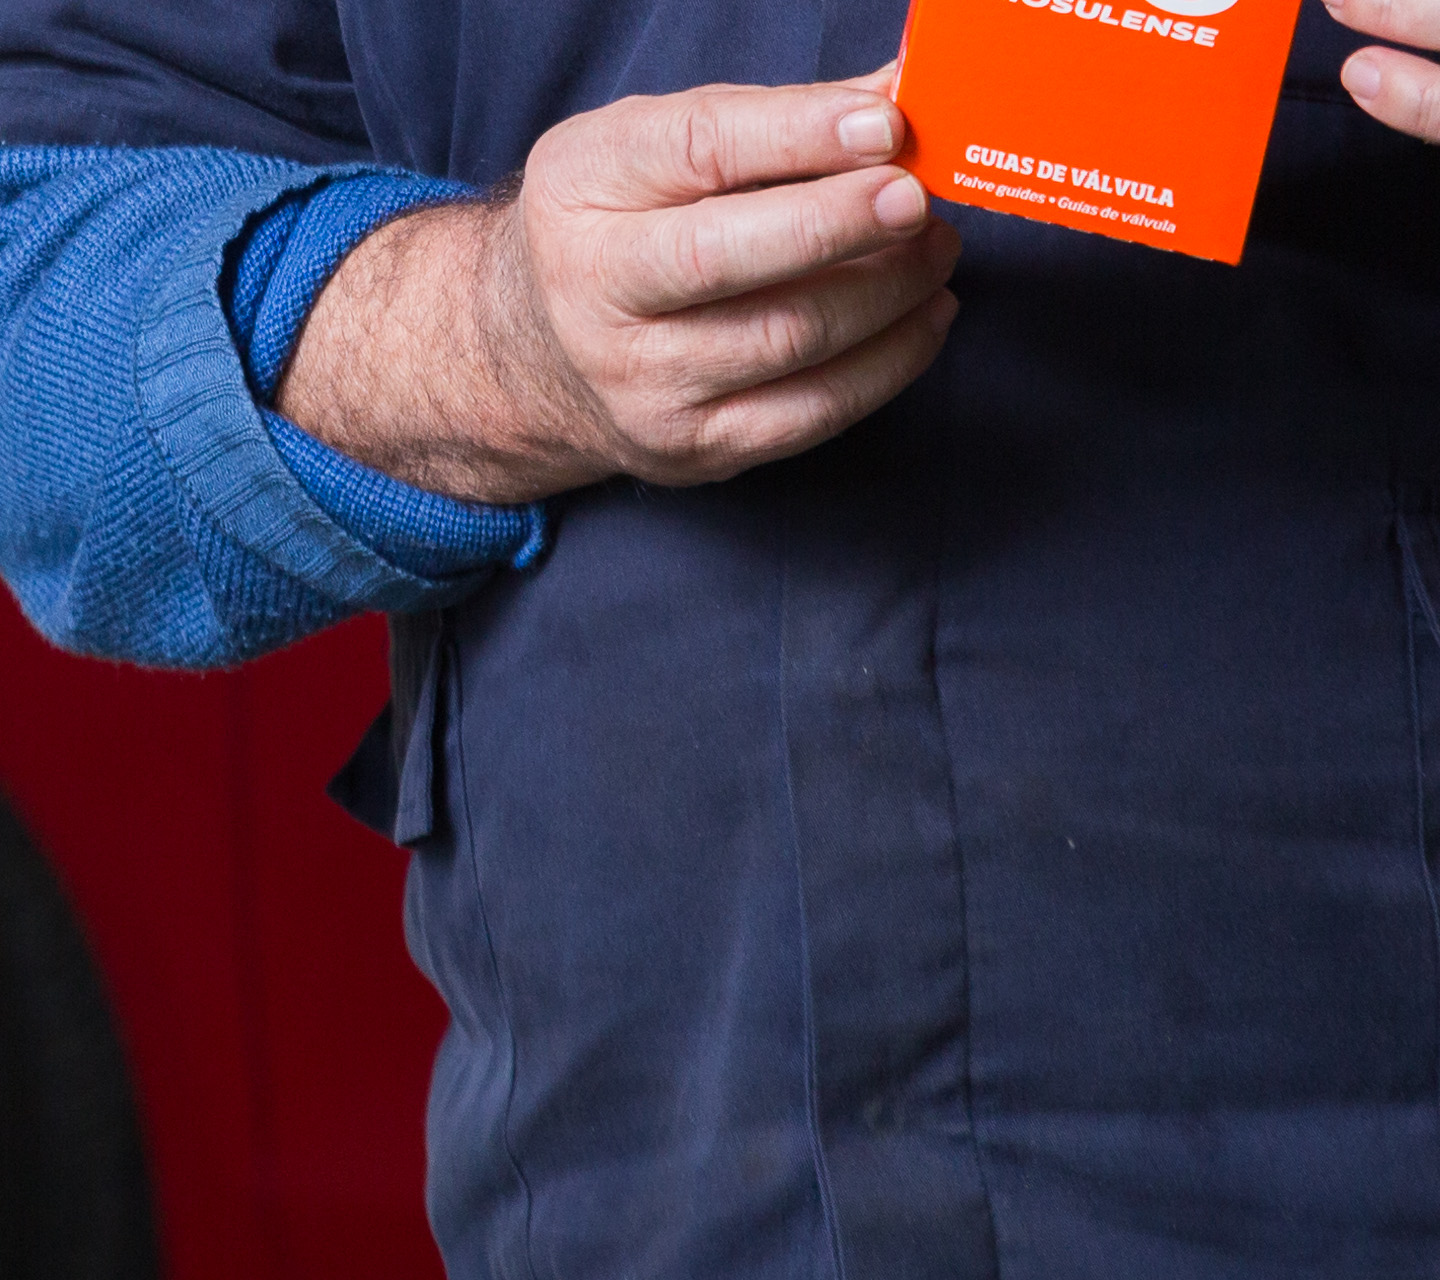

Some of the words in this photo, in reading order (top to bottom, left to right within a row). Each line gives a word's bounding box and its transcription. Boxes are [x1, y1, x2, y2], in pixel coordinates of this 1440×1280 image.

[953, 171, 996, 192] Valve
[994, 184, 1047, 205] guides
[1099, 206, 1120, 221] de
[1121, 212, 1177, 234] válvula
[964, 144, 1035, 176] GUIAS
[1036, 160, 1068, 184] DE
[1071, 168, 1175, 208] VÁLVULA
